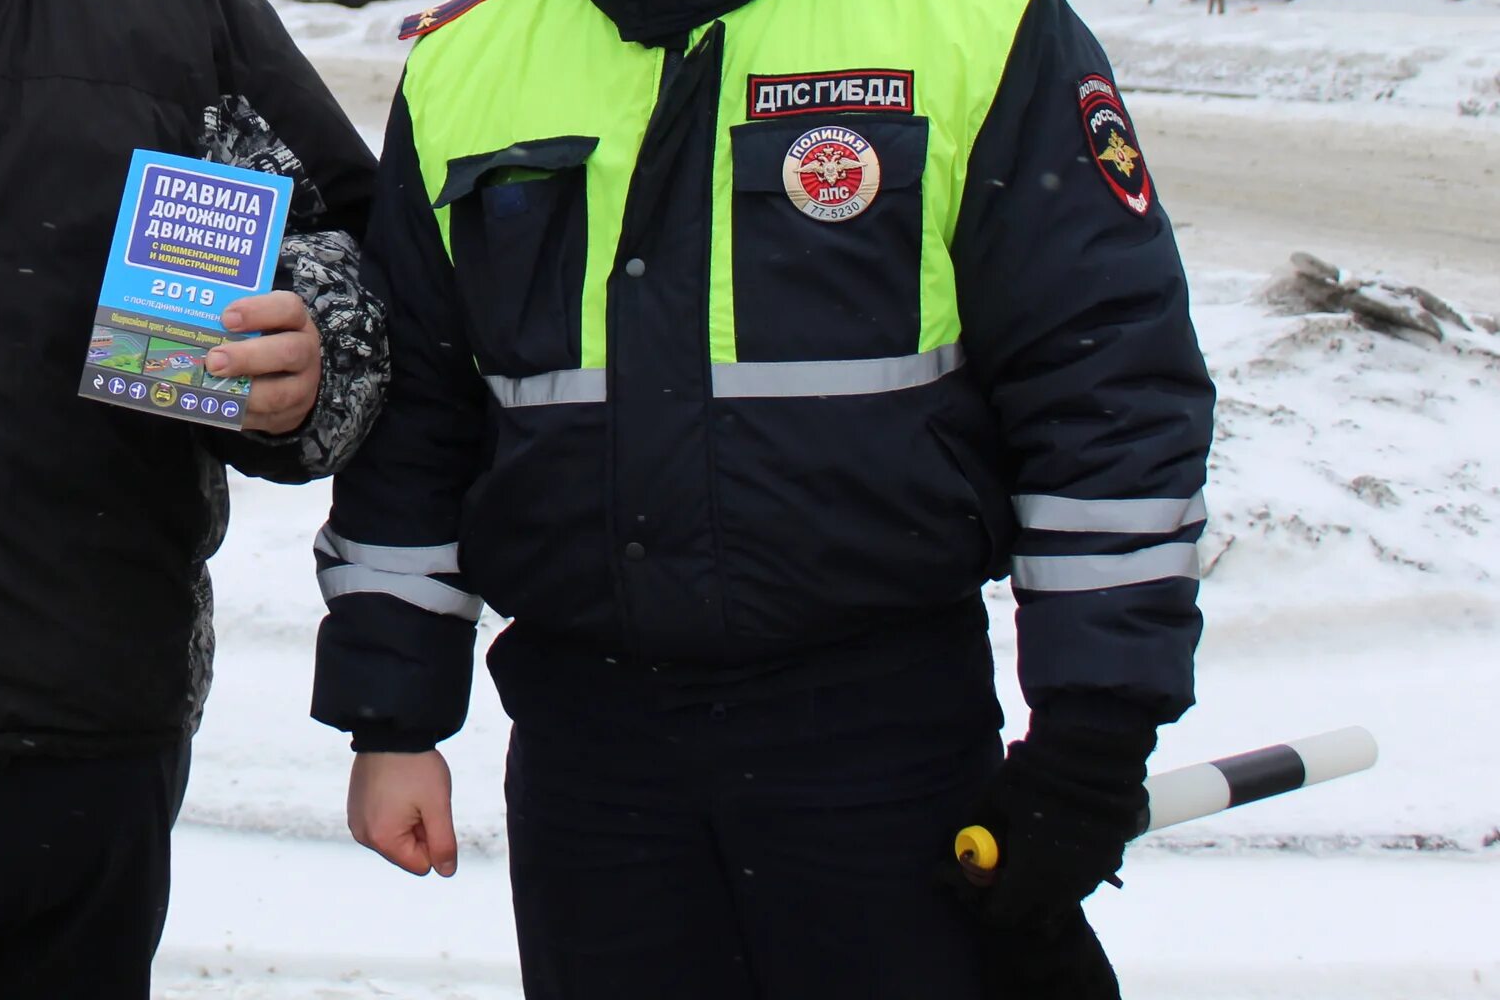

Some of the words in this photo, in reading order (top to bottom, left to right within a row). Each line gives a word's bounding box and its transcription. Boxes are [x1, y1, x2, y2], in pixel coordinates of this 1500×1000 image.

[755, 83, 810, 112] ДПС
[815, 78, 905, 106] ГИБДД
[1079, 79, 1114, 100] ПОЛИЦИЯ
[1090, 109, 1126, 134] РОССИЯ
[791, 129, 865, 158] ПОЛИЦИЯ
[154, 175, 260, 216] ПРАВИЛА
[818, 186, 850, 201] ДПС
[149, 199, 257, 235] ДОРОЖНОГО
[810, 201, 860, 219] 77-5230
[145, 219, 253, 255] ДВИЖЕНИЯ
[158, 253, 238, 277] ИЛЛЮСТРАЦИЯМИ
[160, 243, 240, 266] КОММЕНТАРИЯМИ
[151, 279, 215, 306] 2019
[130, 296, 183, 314] ПОСЛЕДНИМИ
[184, 308, 221, 321] ИЗМЕНЕН
